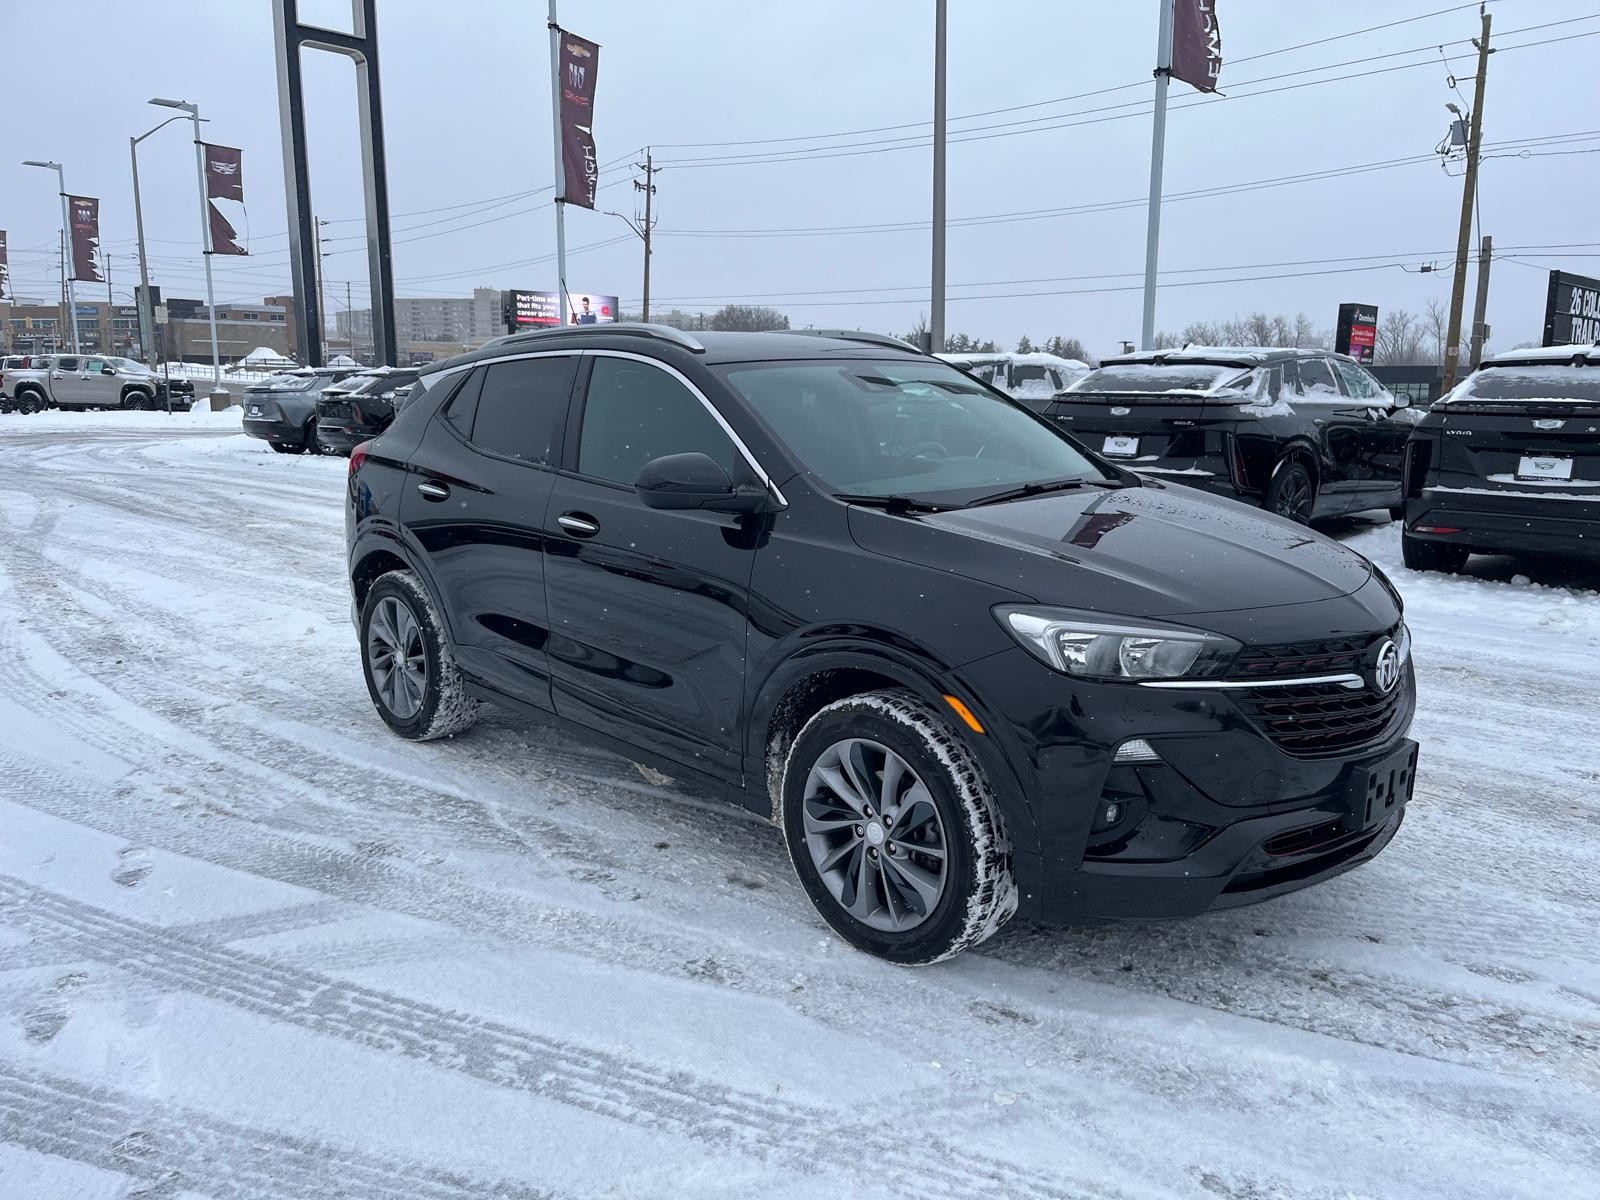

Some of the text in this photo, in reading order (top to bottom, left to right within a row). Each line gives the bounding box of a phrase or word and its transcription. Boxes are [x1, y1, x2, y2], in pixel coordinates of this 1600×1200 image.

[517, 294, 546, 303] Part-time
[1570, 287, 1582, 315] 26
[1571, 317, 1600, 345] TRAILB
